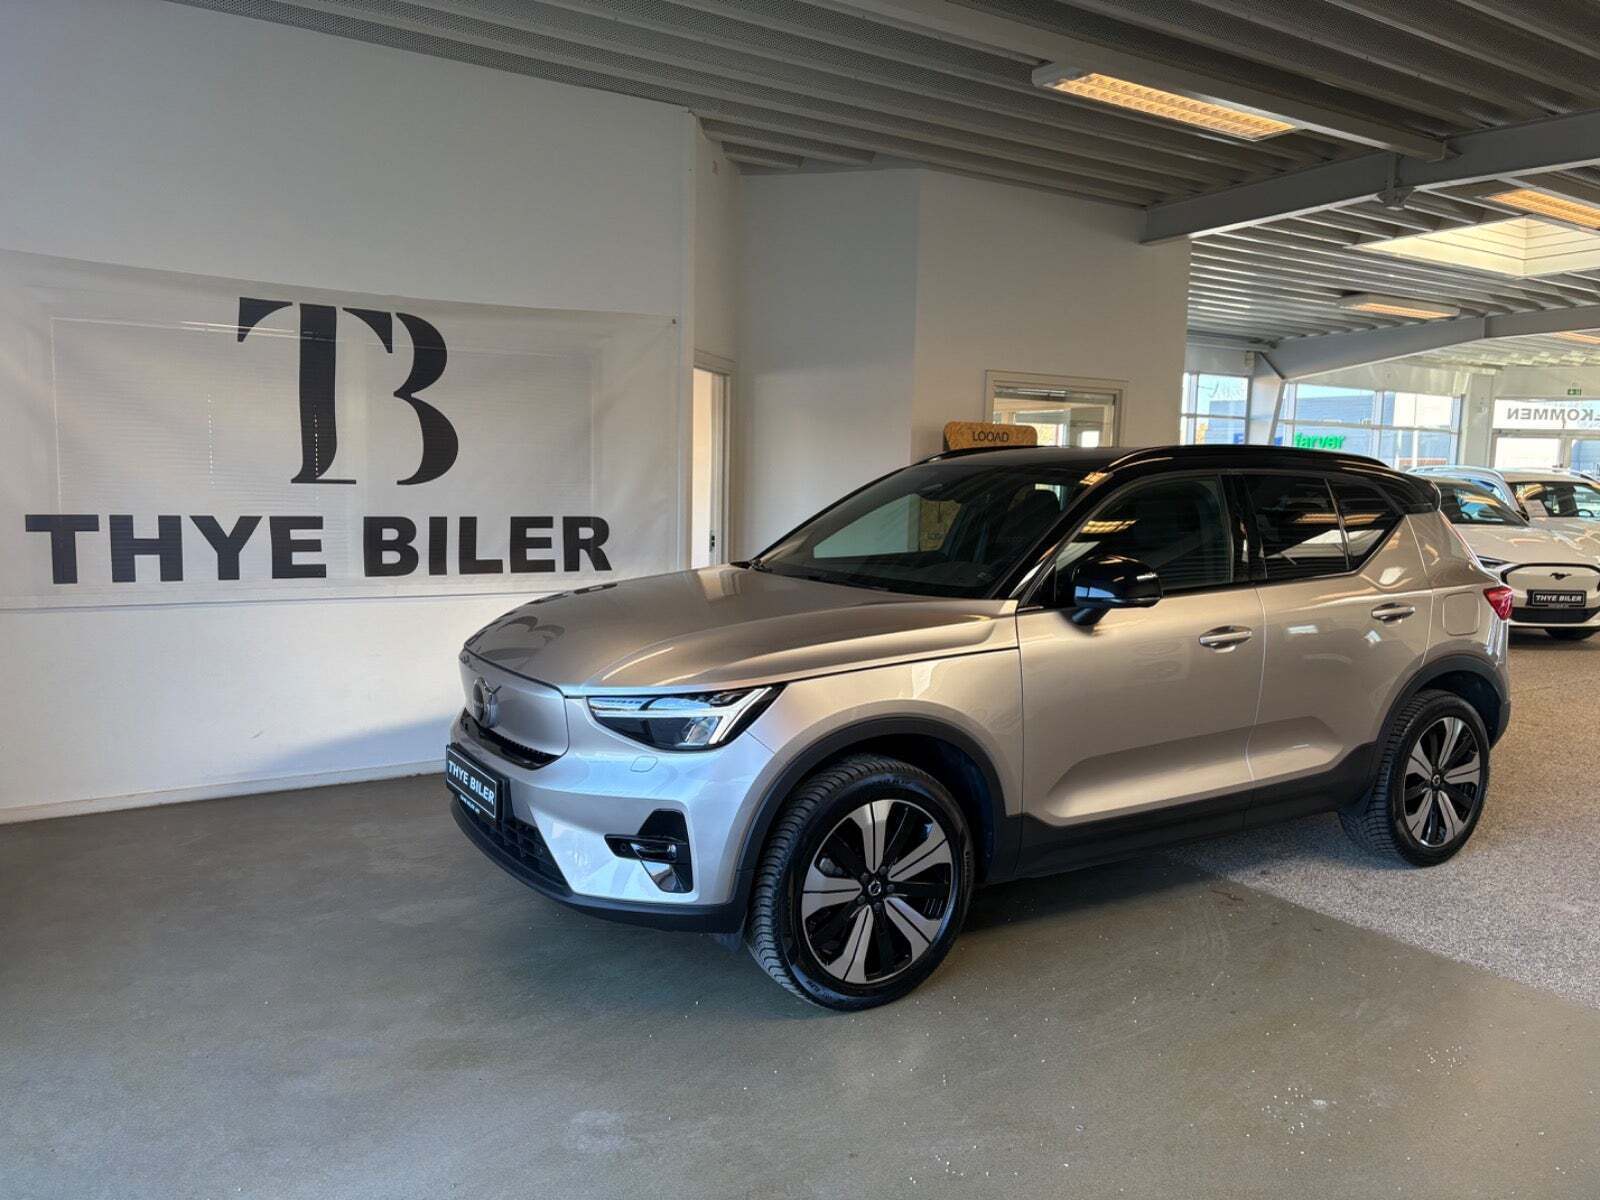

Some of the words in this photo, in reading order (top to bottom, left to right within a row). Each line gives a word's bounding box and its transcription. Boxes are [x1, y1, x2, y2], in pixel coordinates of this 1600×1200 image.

[25, 514, 327, 585] THYE
[363, 516, 612, 577] BILER
[448, 760, 469, 785] THYE
[469, 777, 495, 804] BILER
